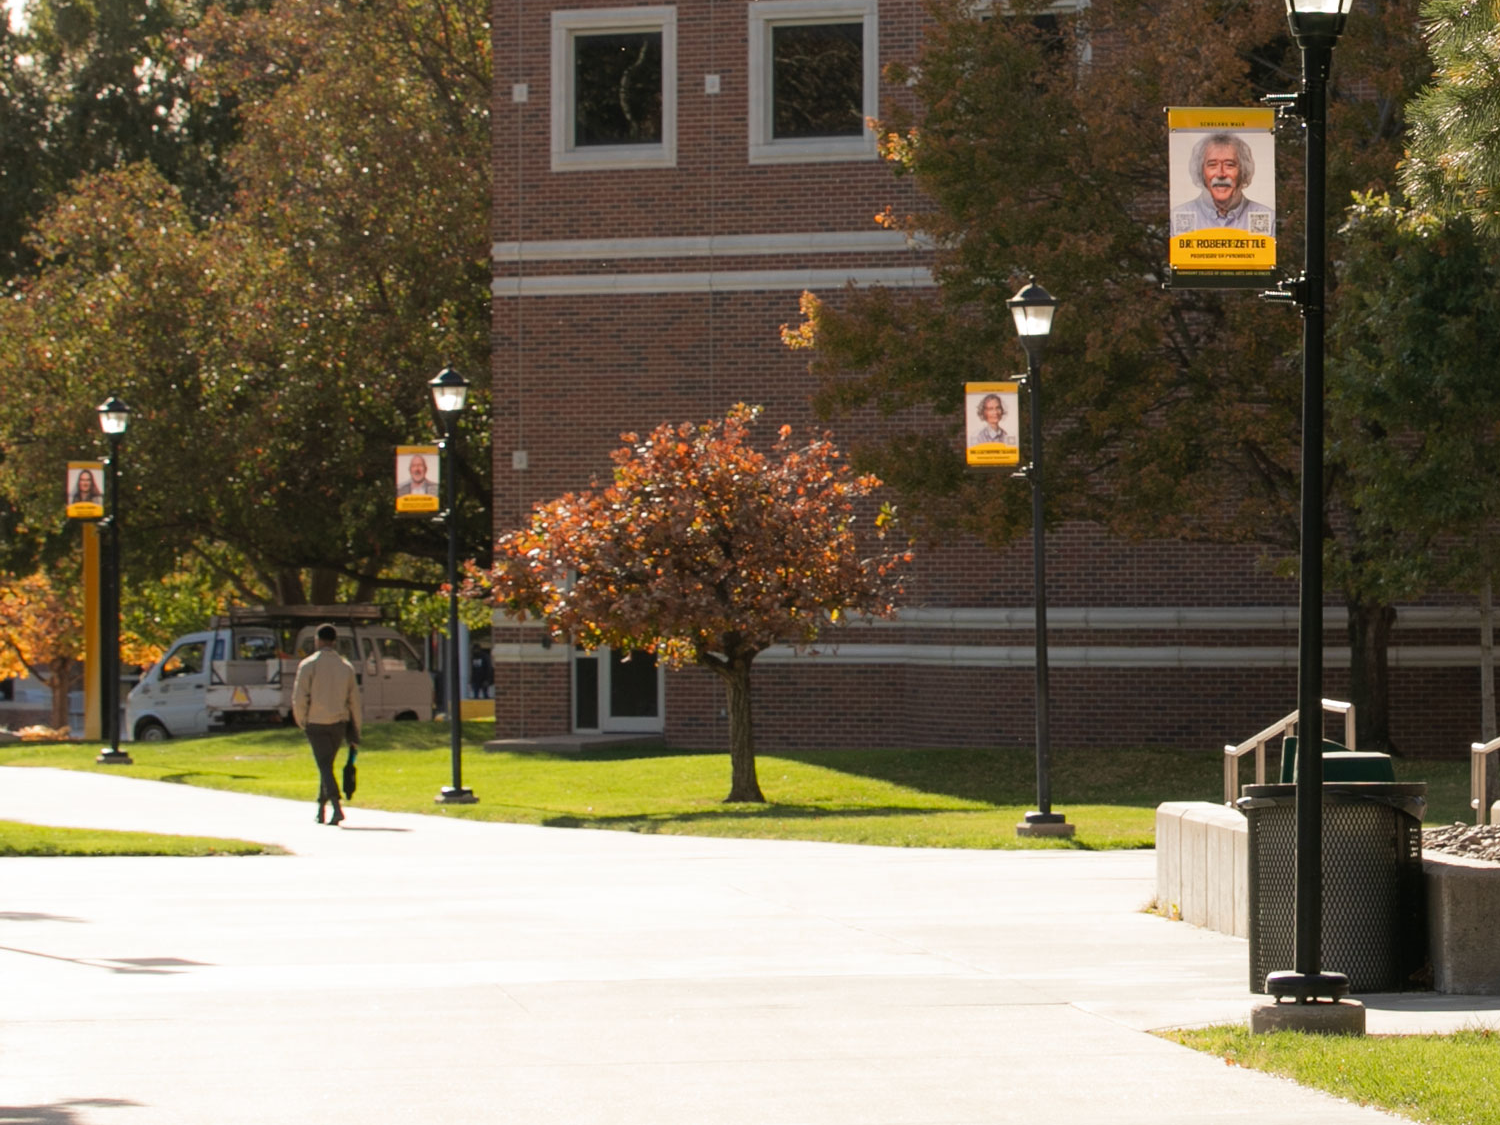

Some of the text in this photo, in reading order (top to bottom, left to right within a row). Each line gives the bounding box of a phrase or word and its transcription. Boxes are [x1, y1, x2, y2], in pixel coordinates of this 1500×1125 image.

[1179, 239, 1266, 248] DR. ROBERT ZETTLE
